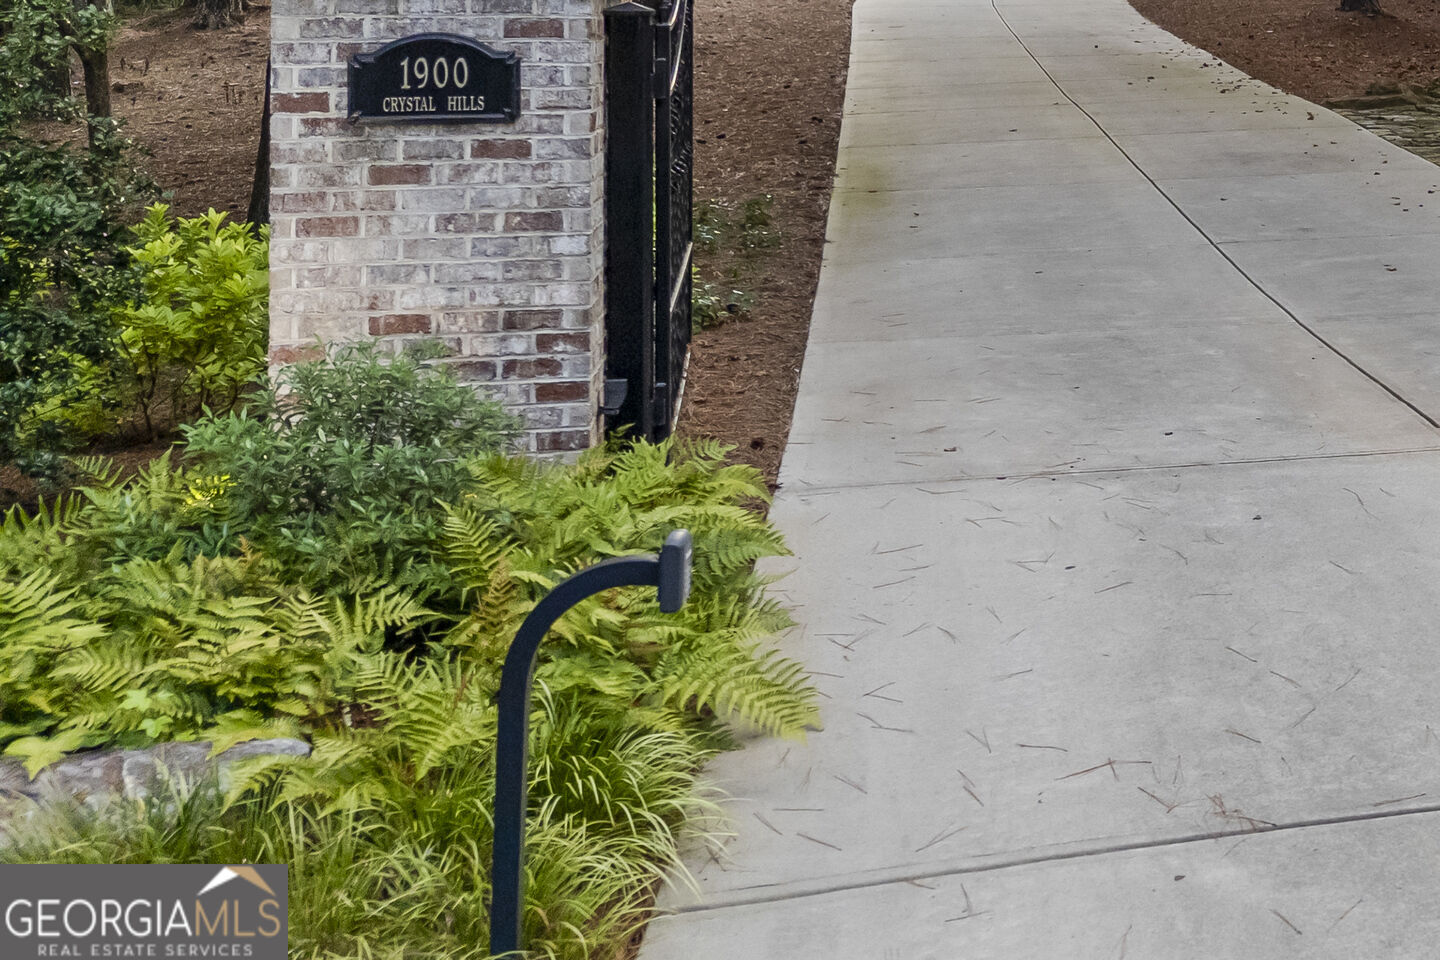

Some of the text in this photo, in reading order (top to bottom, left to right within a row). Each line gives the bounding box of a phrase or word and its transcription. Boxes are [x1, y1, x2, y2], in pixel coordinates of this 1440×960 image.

[400, 56, 469, 89] 1900
[382, 96, 485, 112] CRYSTAL HILLS
